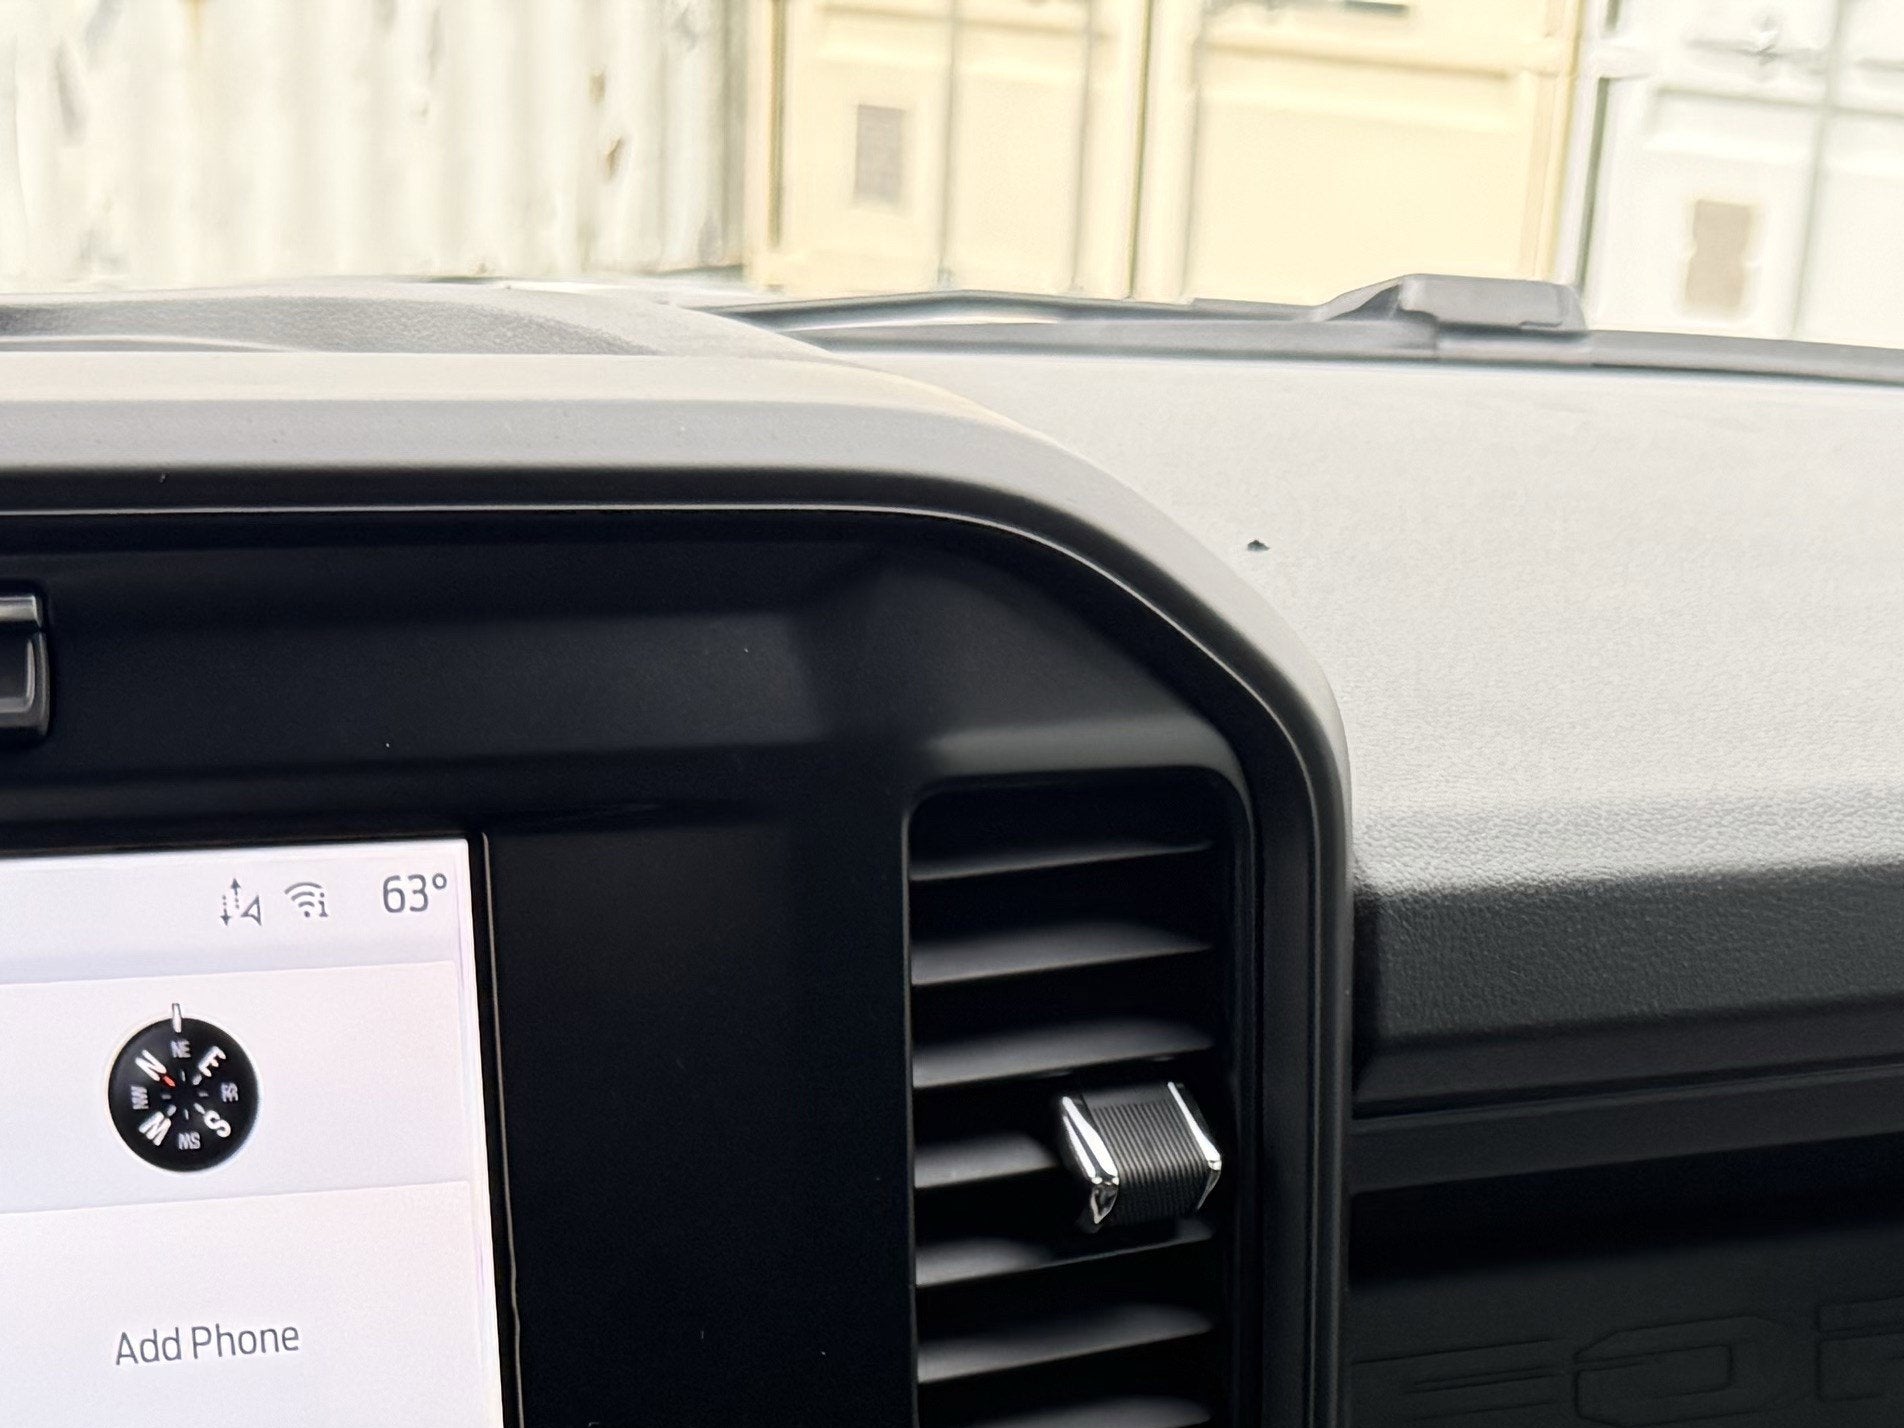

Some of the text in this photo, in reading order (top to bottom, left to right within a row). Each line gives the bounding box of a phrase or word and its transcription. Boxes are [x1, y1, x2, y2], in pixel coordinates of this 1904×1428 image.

[382, 872, 448, 914] 63°
[135, 1050, 167, 1081] N
[198, 1046, 226, 1077] E
[204, 1110, 231, 1138] S
[114, 1321, 300, 1367] Add Phone
